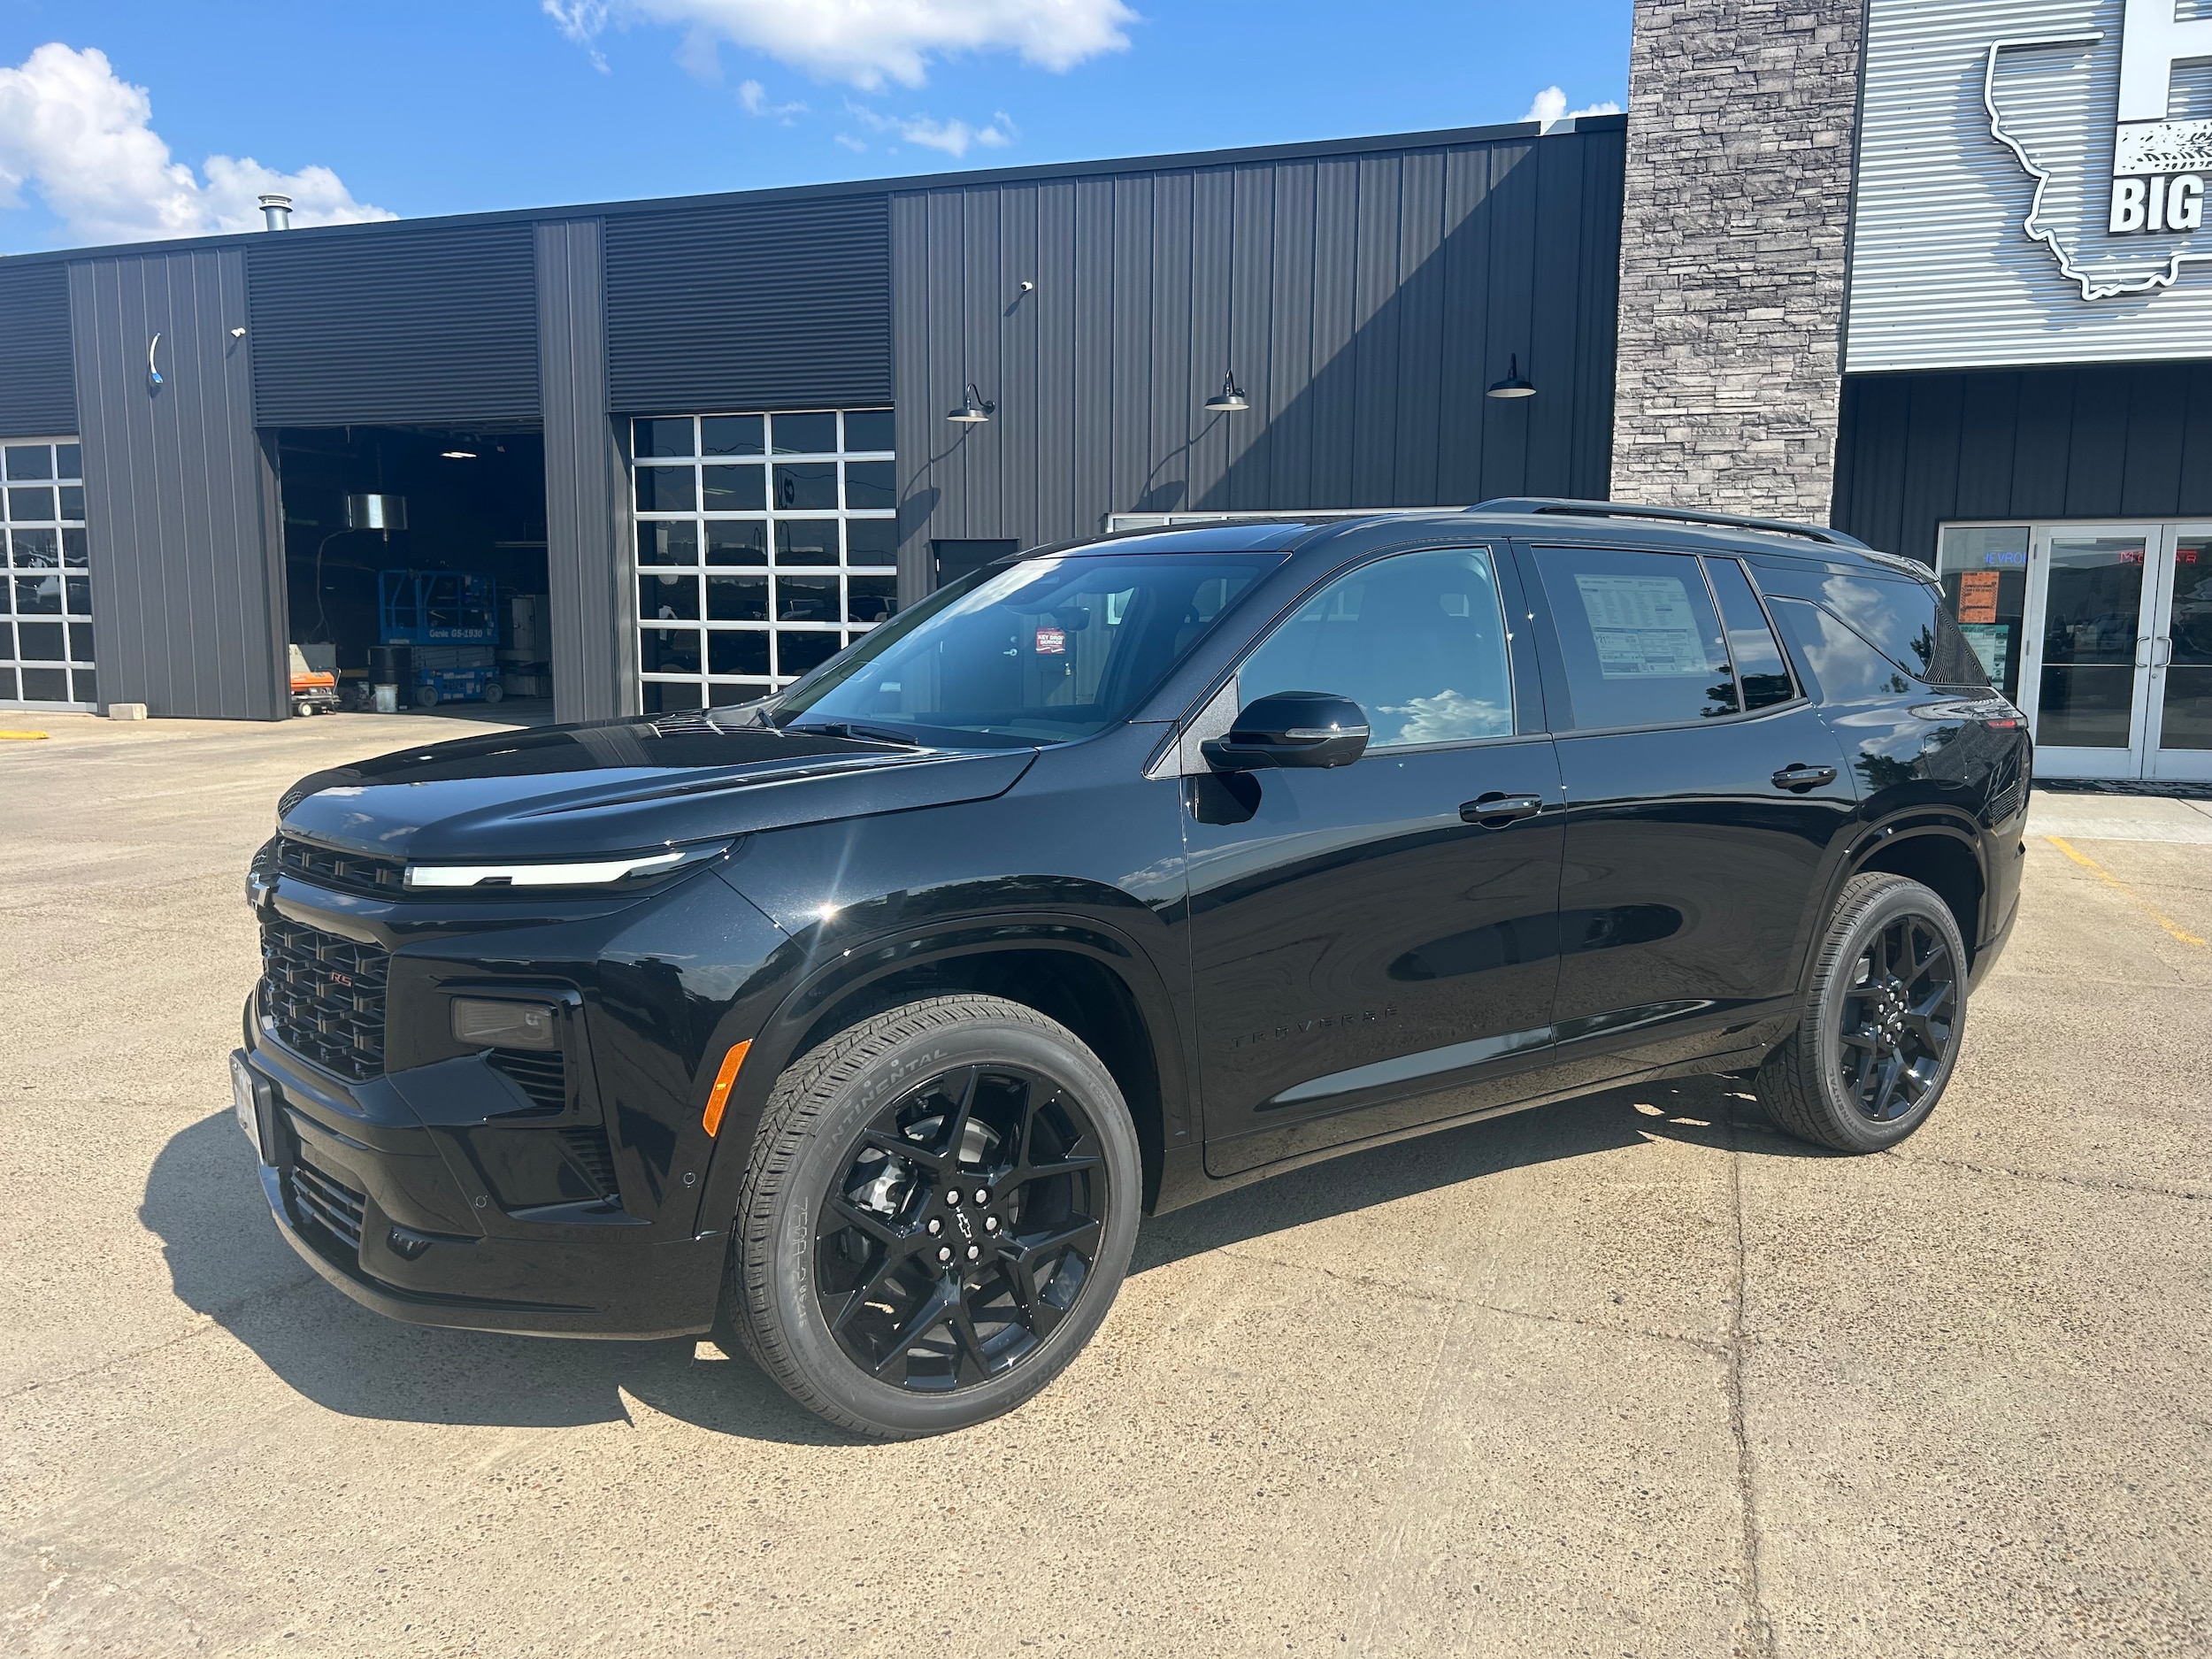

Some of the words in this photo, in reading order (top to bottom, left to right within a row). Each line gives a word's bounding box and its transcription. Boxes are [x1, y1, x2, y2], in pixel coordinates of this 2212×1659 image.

[2109, 173, 2205, 233] BIG
[330, 971, 352, 987] RS
[1232, 1007, 1398, 1048] TRAVERSE
